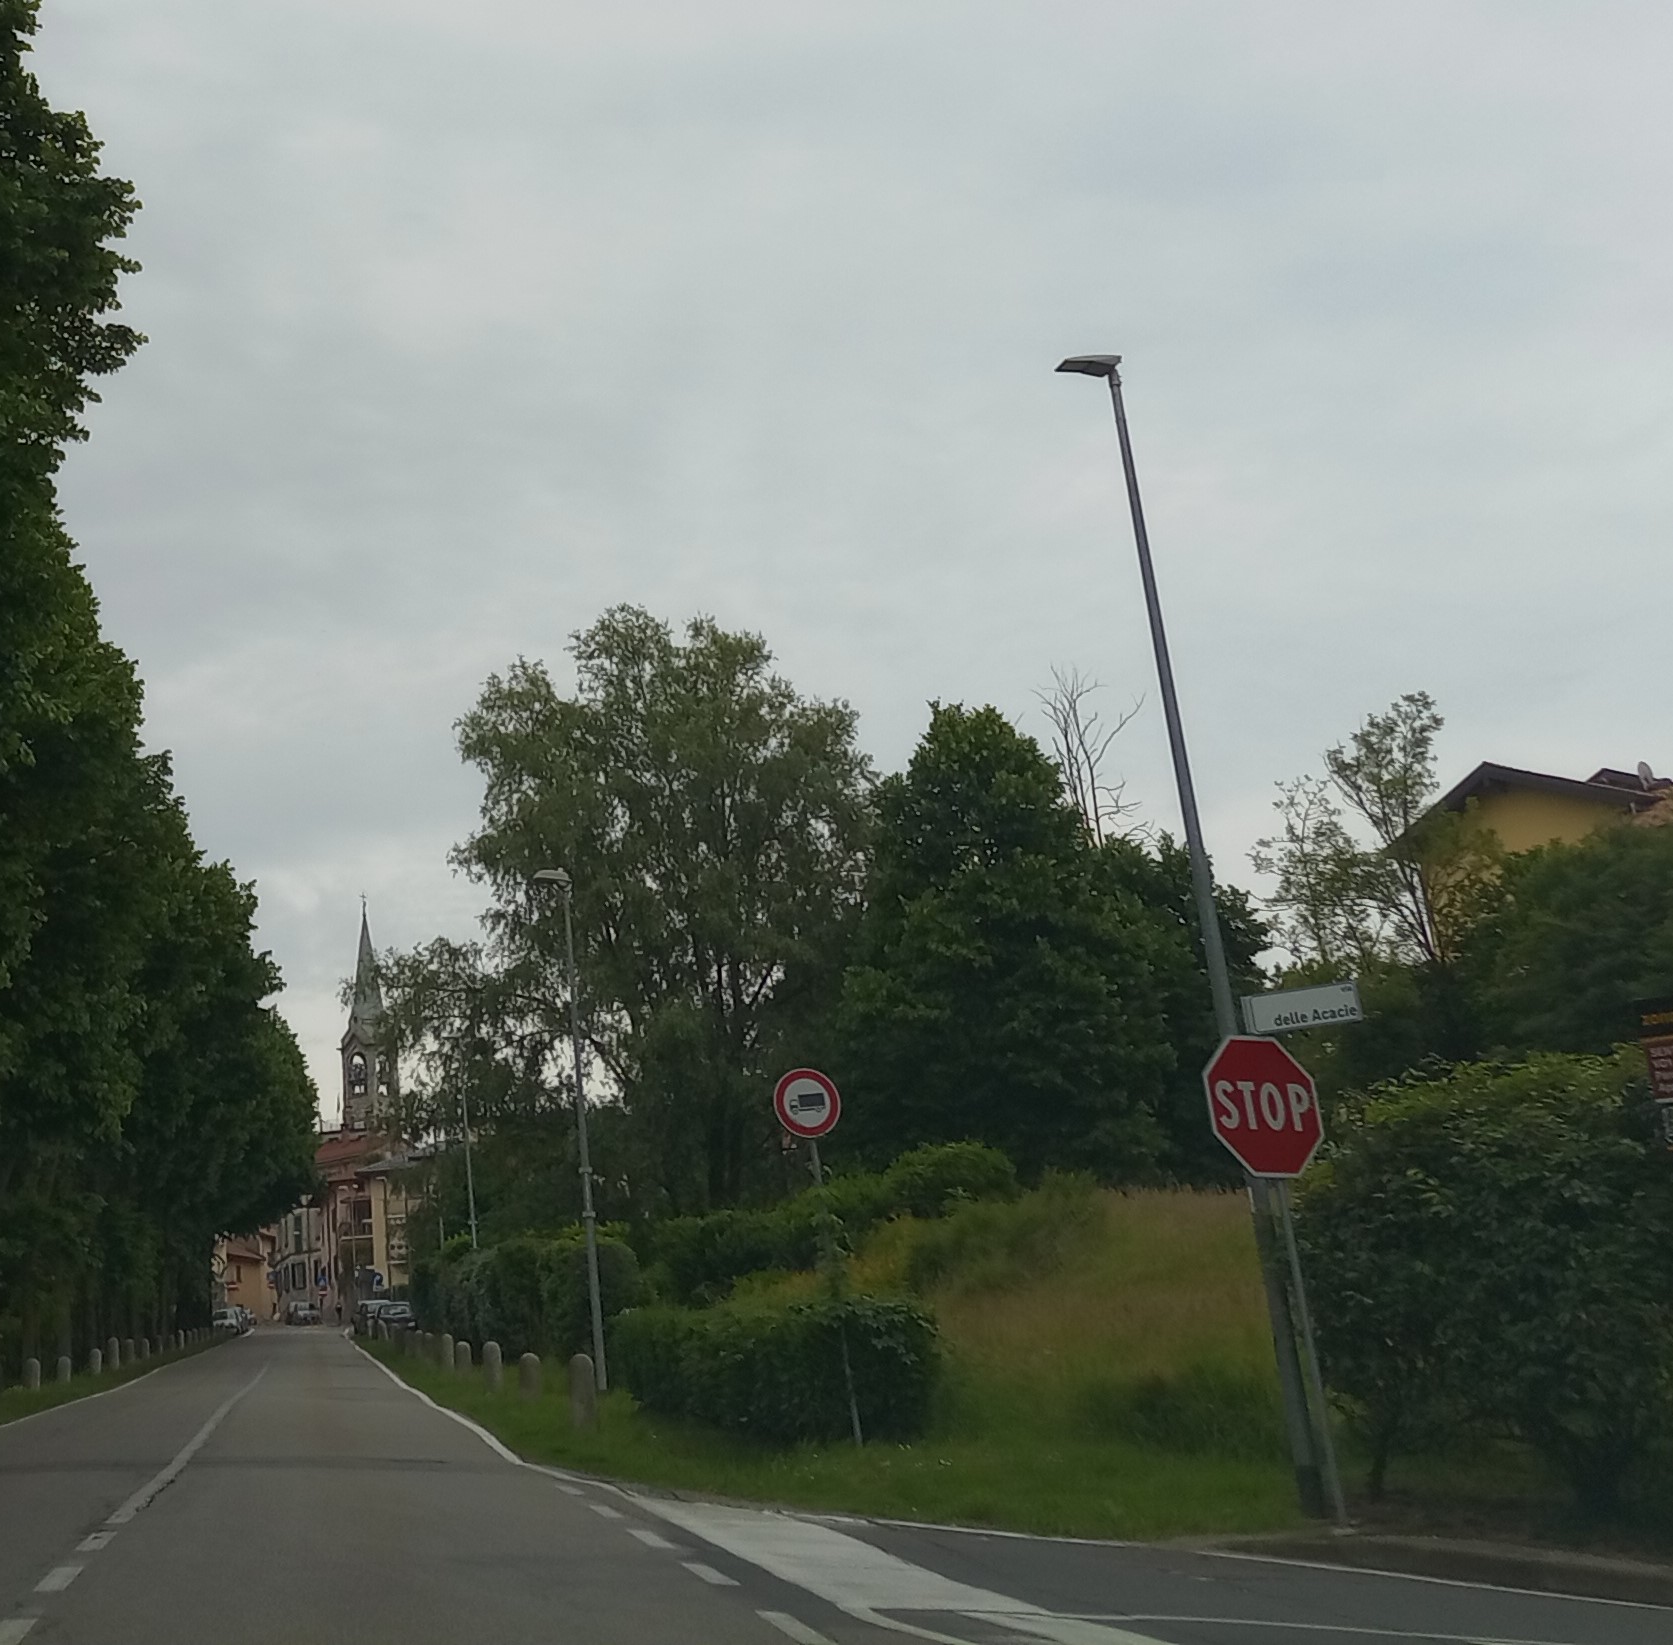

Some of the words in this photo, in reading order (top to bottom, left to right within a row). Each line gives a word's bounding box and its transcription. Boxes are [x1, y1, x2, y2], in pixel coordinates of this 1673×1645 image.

[1273, 1011, 1309, 1027] delle
[1312, 1004, 1358, 1022] Acacie
[1214, 1079, 1313, 1132] STOP
